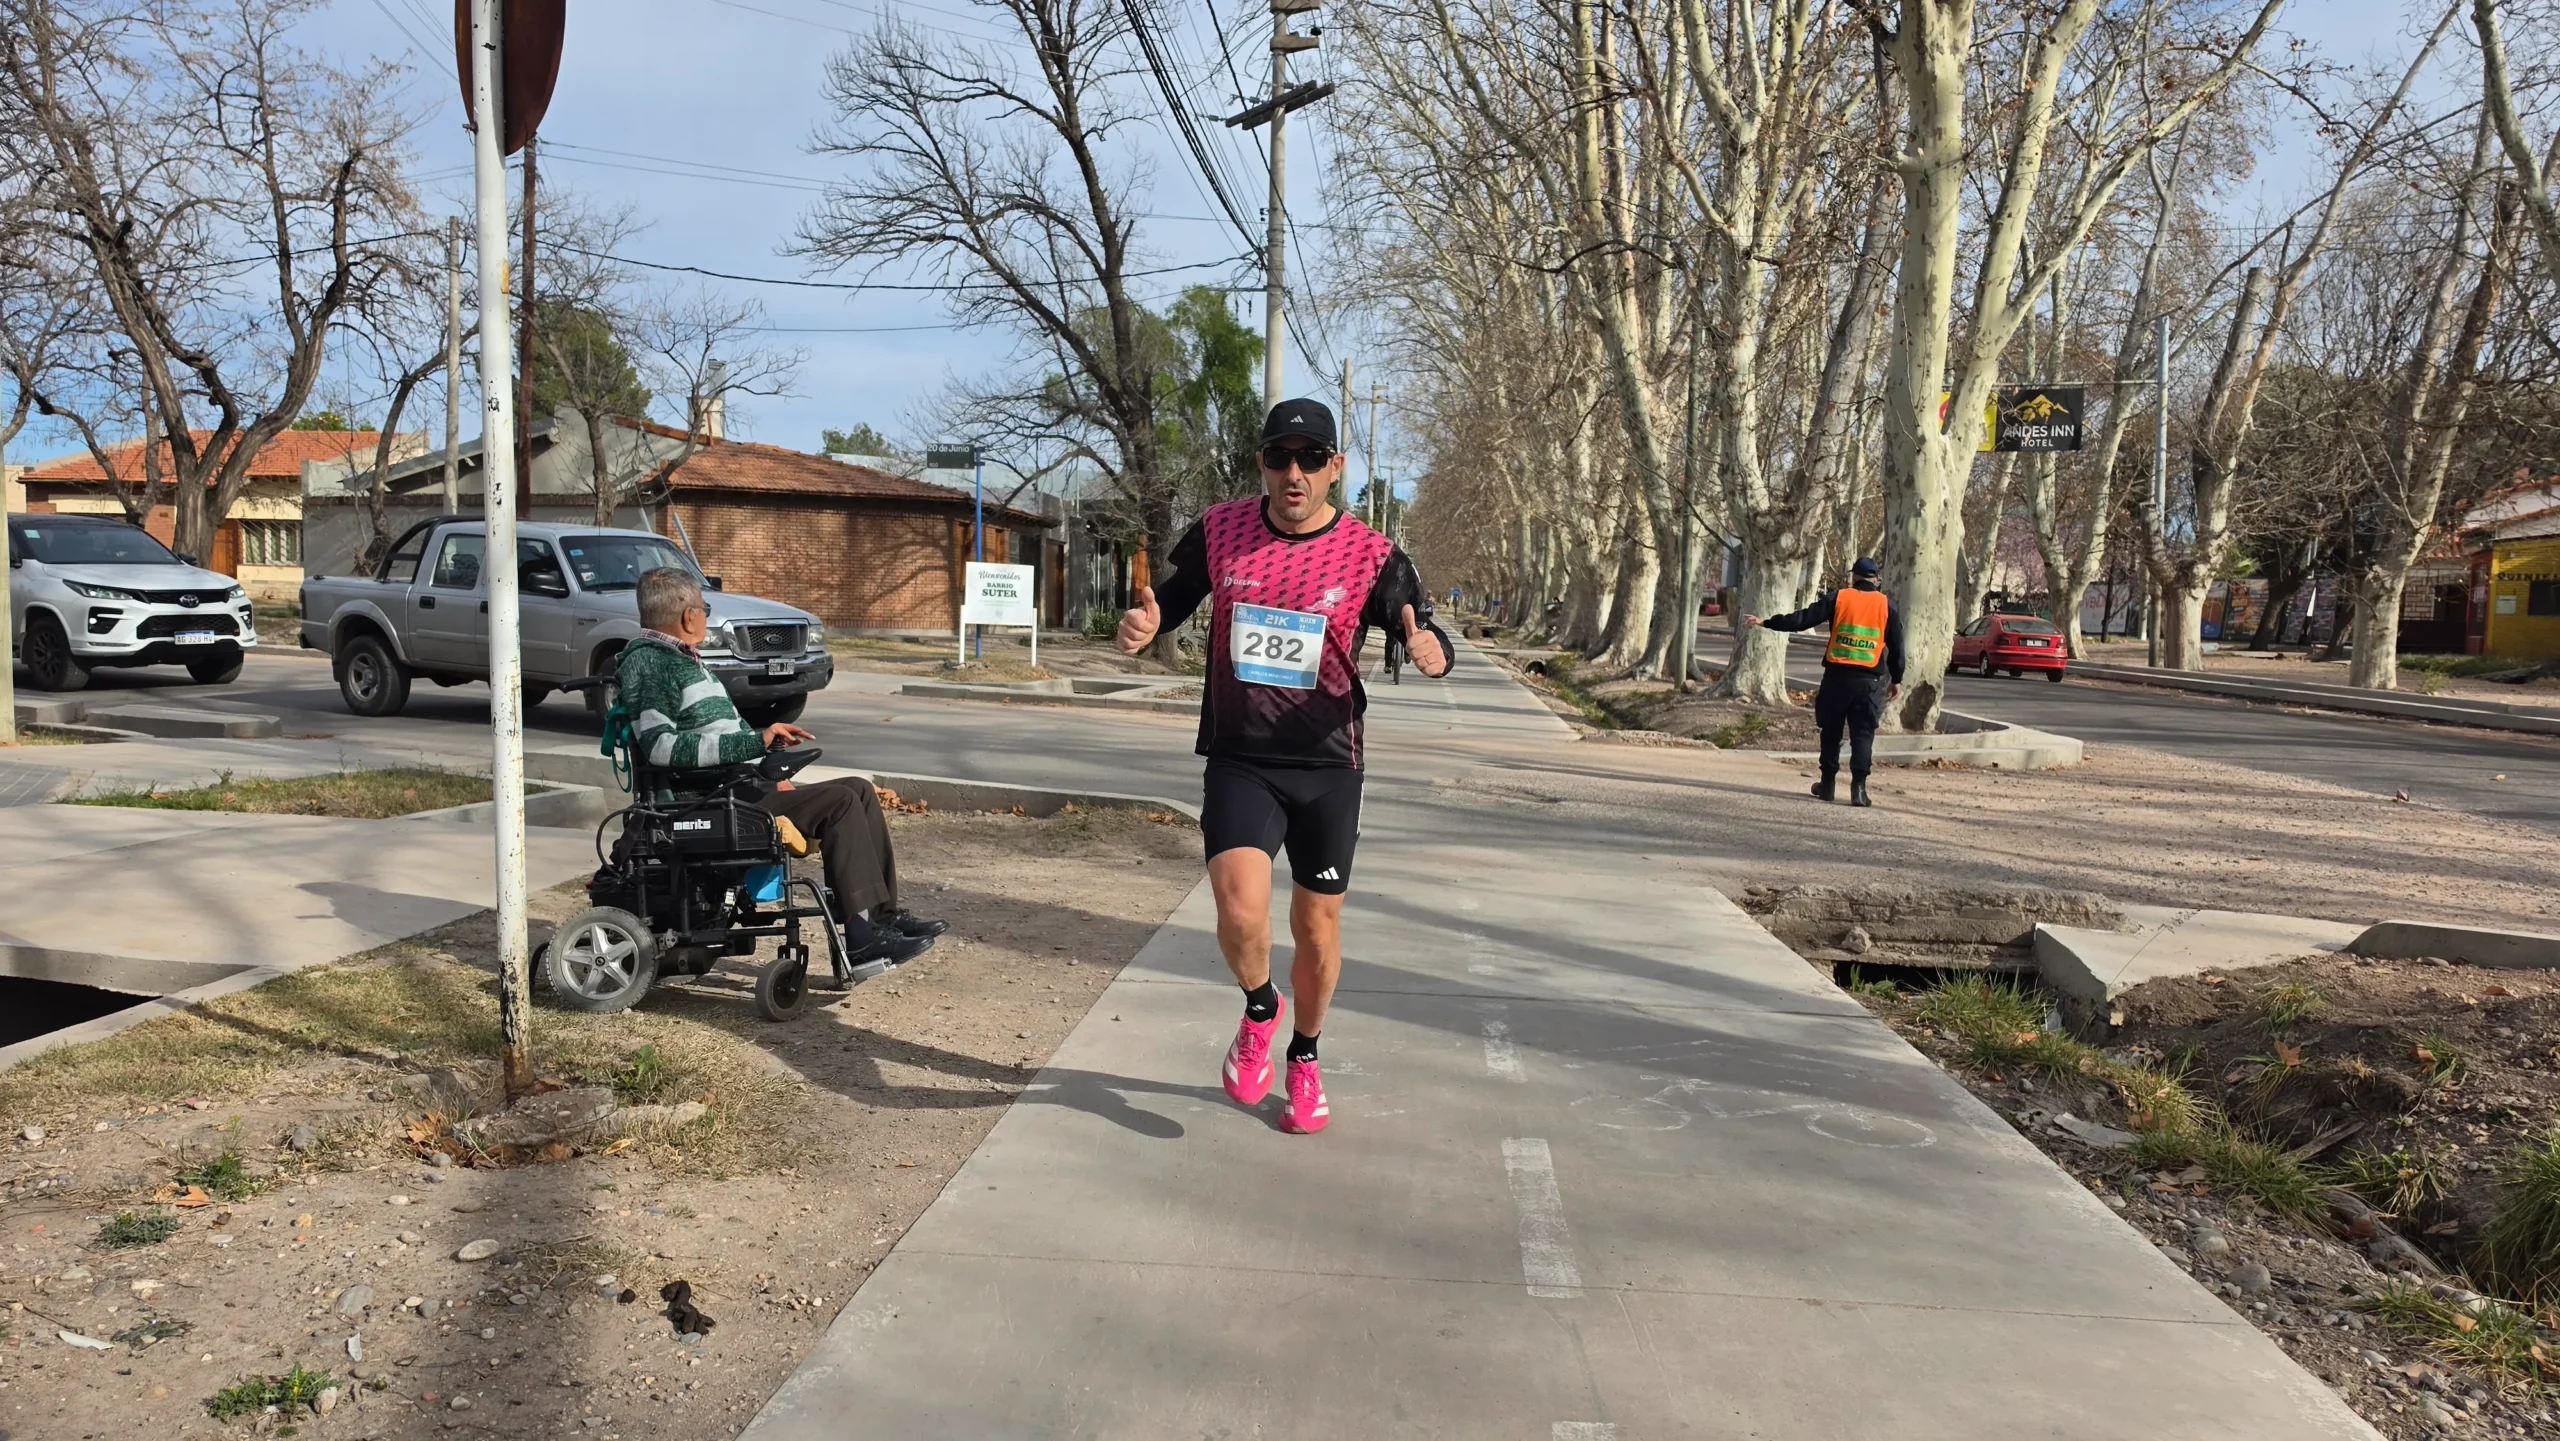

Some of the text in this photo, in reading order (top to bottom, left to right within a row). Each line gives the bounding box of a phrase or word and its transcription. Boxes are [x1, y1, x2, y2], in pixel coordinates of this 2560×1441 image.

[2002, 424, 2075, 438] ANDES INN
[927, 444, 970, 453] 20 de Junio
[2021, 439, 2054, 448] HOTEL
[978, 570, 1021, 581] Bienvenidos
[982, 589, 1018, 598] SUTER
[1264, 614, 1290, 627] 21K
[177, 635, 186, 643] AG
[1835, 634, 1875, 649] POLICIA
[1242, 632, 1304, 663] 282
[673, 818, 711, 831] merits
